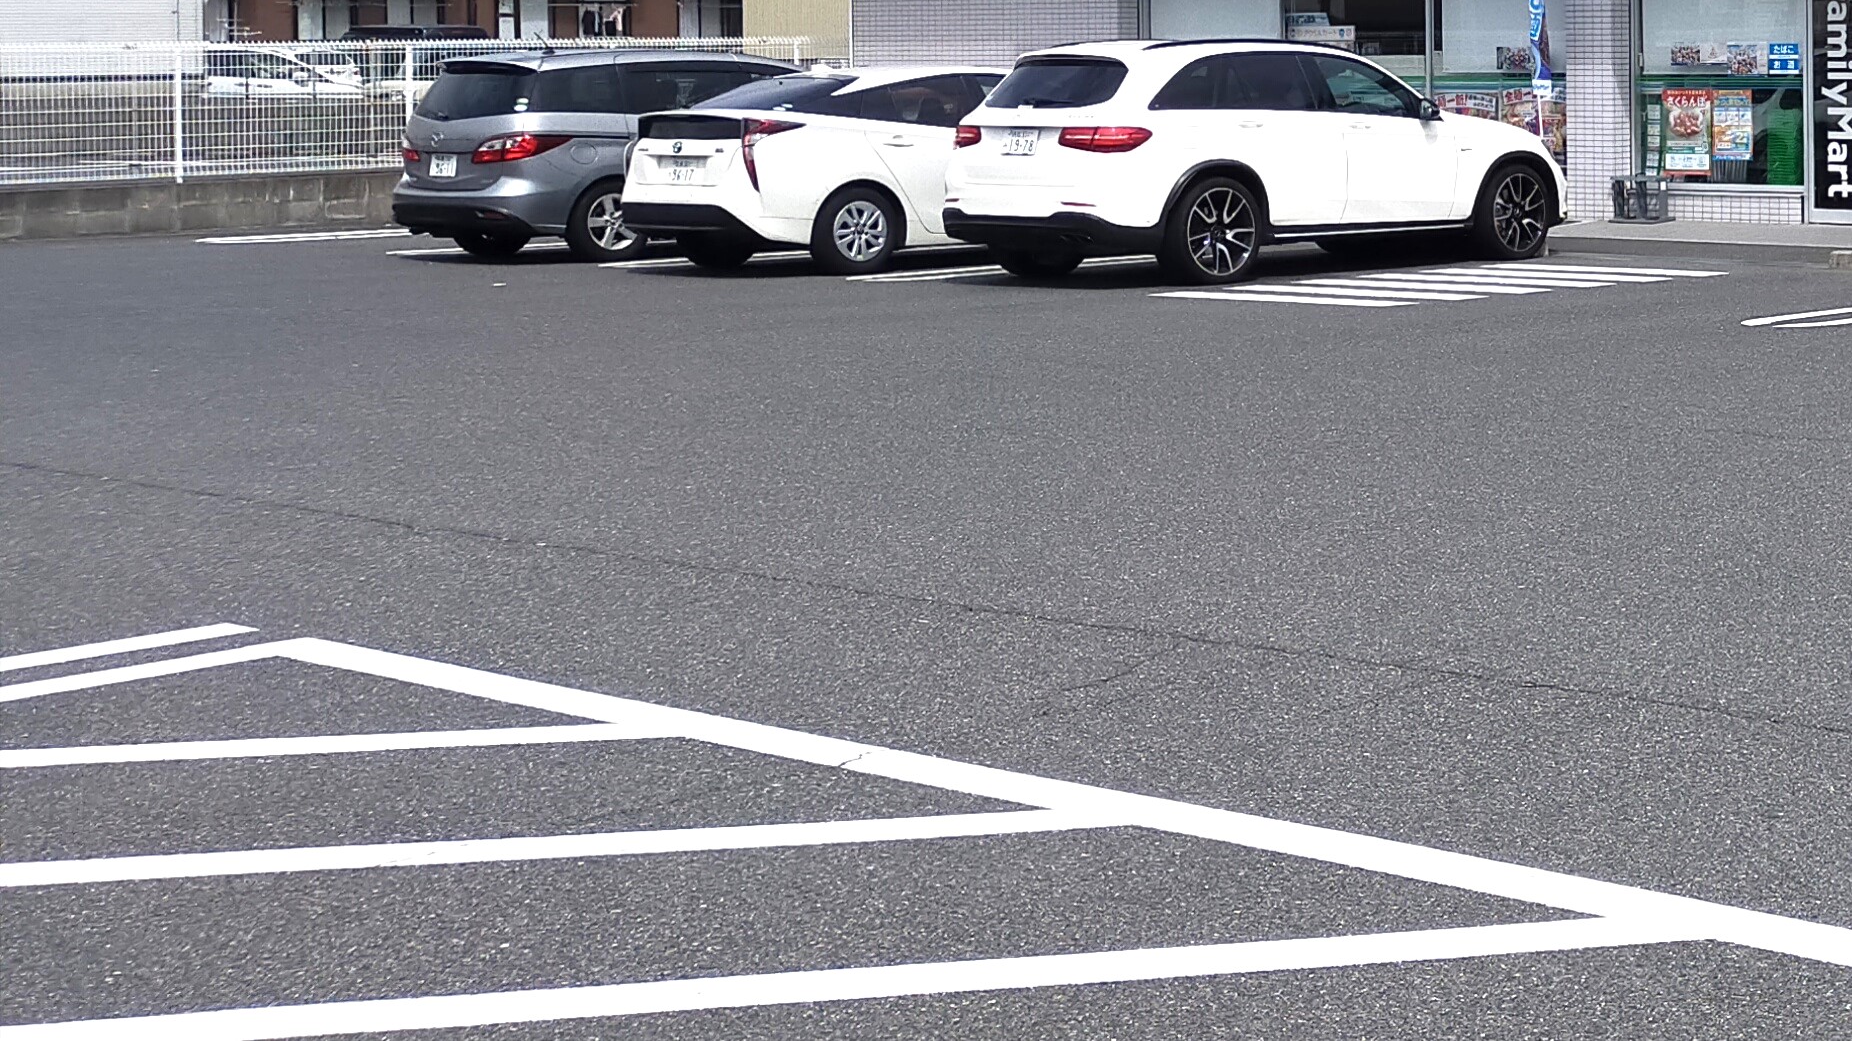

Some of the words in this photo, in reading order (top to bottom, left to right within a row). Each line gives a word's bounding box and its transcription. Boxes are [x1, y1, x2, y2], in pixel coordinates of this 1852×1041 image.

[1773, 46, 1794, 54] たばこ
[1667, 95, 1708, 107] さくらんぼ
